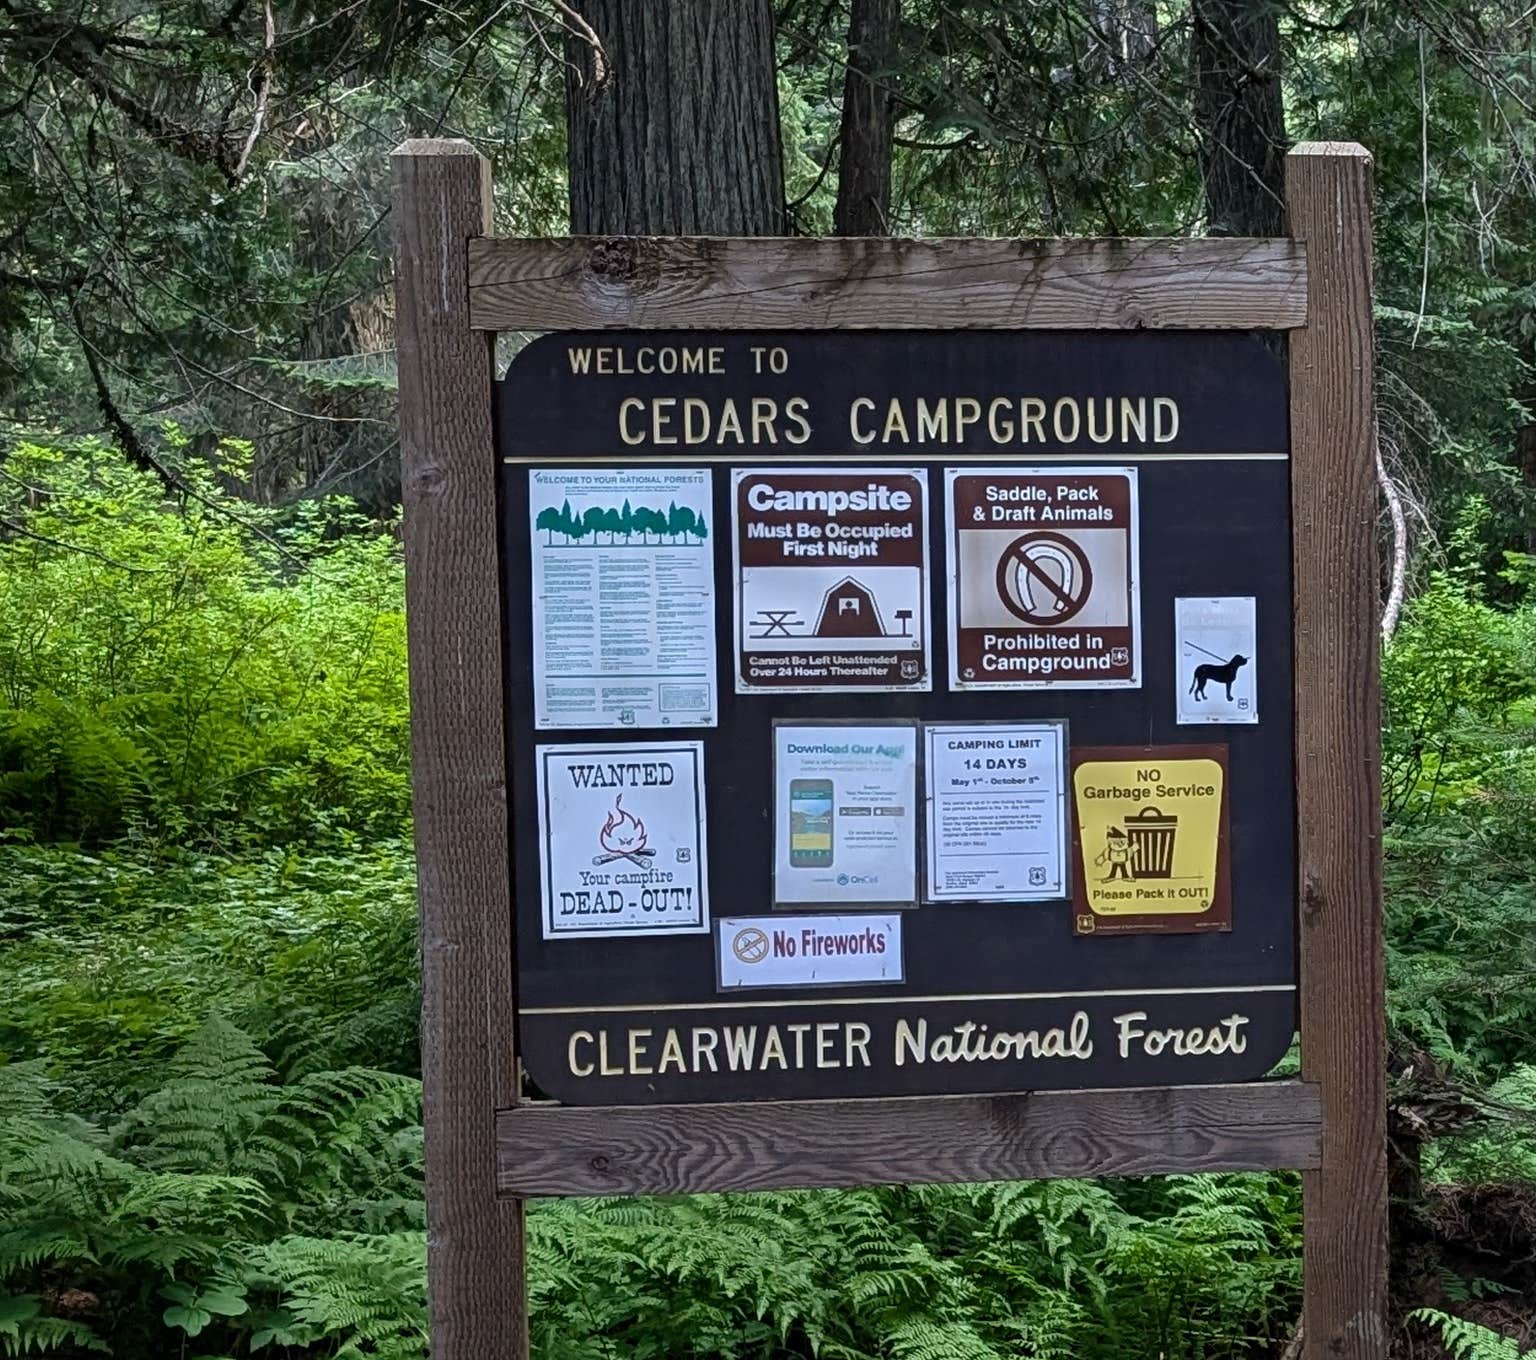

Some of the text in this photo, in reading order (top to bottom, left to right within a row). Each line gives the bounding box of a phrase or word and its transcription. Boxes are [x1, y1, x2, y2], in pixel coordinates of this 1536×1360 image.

[568, 347, 788, 374] WELCOME TO
[619, 397, 1180, 445] CEDARS CAMPGROUND
[536, 475, 704, 484] WELCOME TO YOUR NATIONAL FORESTS
[748, 483, 912, 516] Campsite
[986, 486, 1099, 503] Saddle, Pack
[973, 505, 1114, 521] & Draft Animals
[748, 522, 913, 540] Must Be Occupied
[783, 541, 878, 559] First Night
[984, 633, 1103, 650] Prohibited in
[749, 655, 897, 665] Cannot Be Left Unattended
[982, 653, 1111, 673] Campground
[750, 666, 888, 677] Over 24 Hours Thereafter
[787, 744, 849, 754] Download
[852, 744, 874, 754] Our
[948, 739, 1042, 750] CAMPING LIMIT
[964, 758, 1027, 770] 14 DAYS
[568, 762, 674, 788] WANTED
[951, 778, 970, 787] May
[990, 777, 1027, 786] October
[1137, 769, 1161, 782] NO
[1083, 784, 1215, 801] Garbage Service
[579, 868, 673, 888] Your campfire
[560, 890, 623, 915] DEAD
[641, 888, 692, 912] OUT!
[1093, 889, 1132, 900] Please
[1136, 888, 1164, 899] Pack
[1178, 887, 1209, 898] OUT!
[773, 927, 885, 958] No Fireworks
[568, 1010, 1250, 1077] CLEARWATER National Forest
